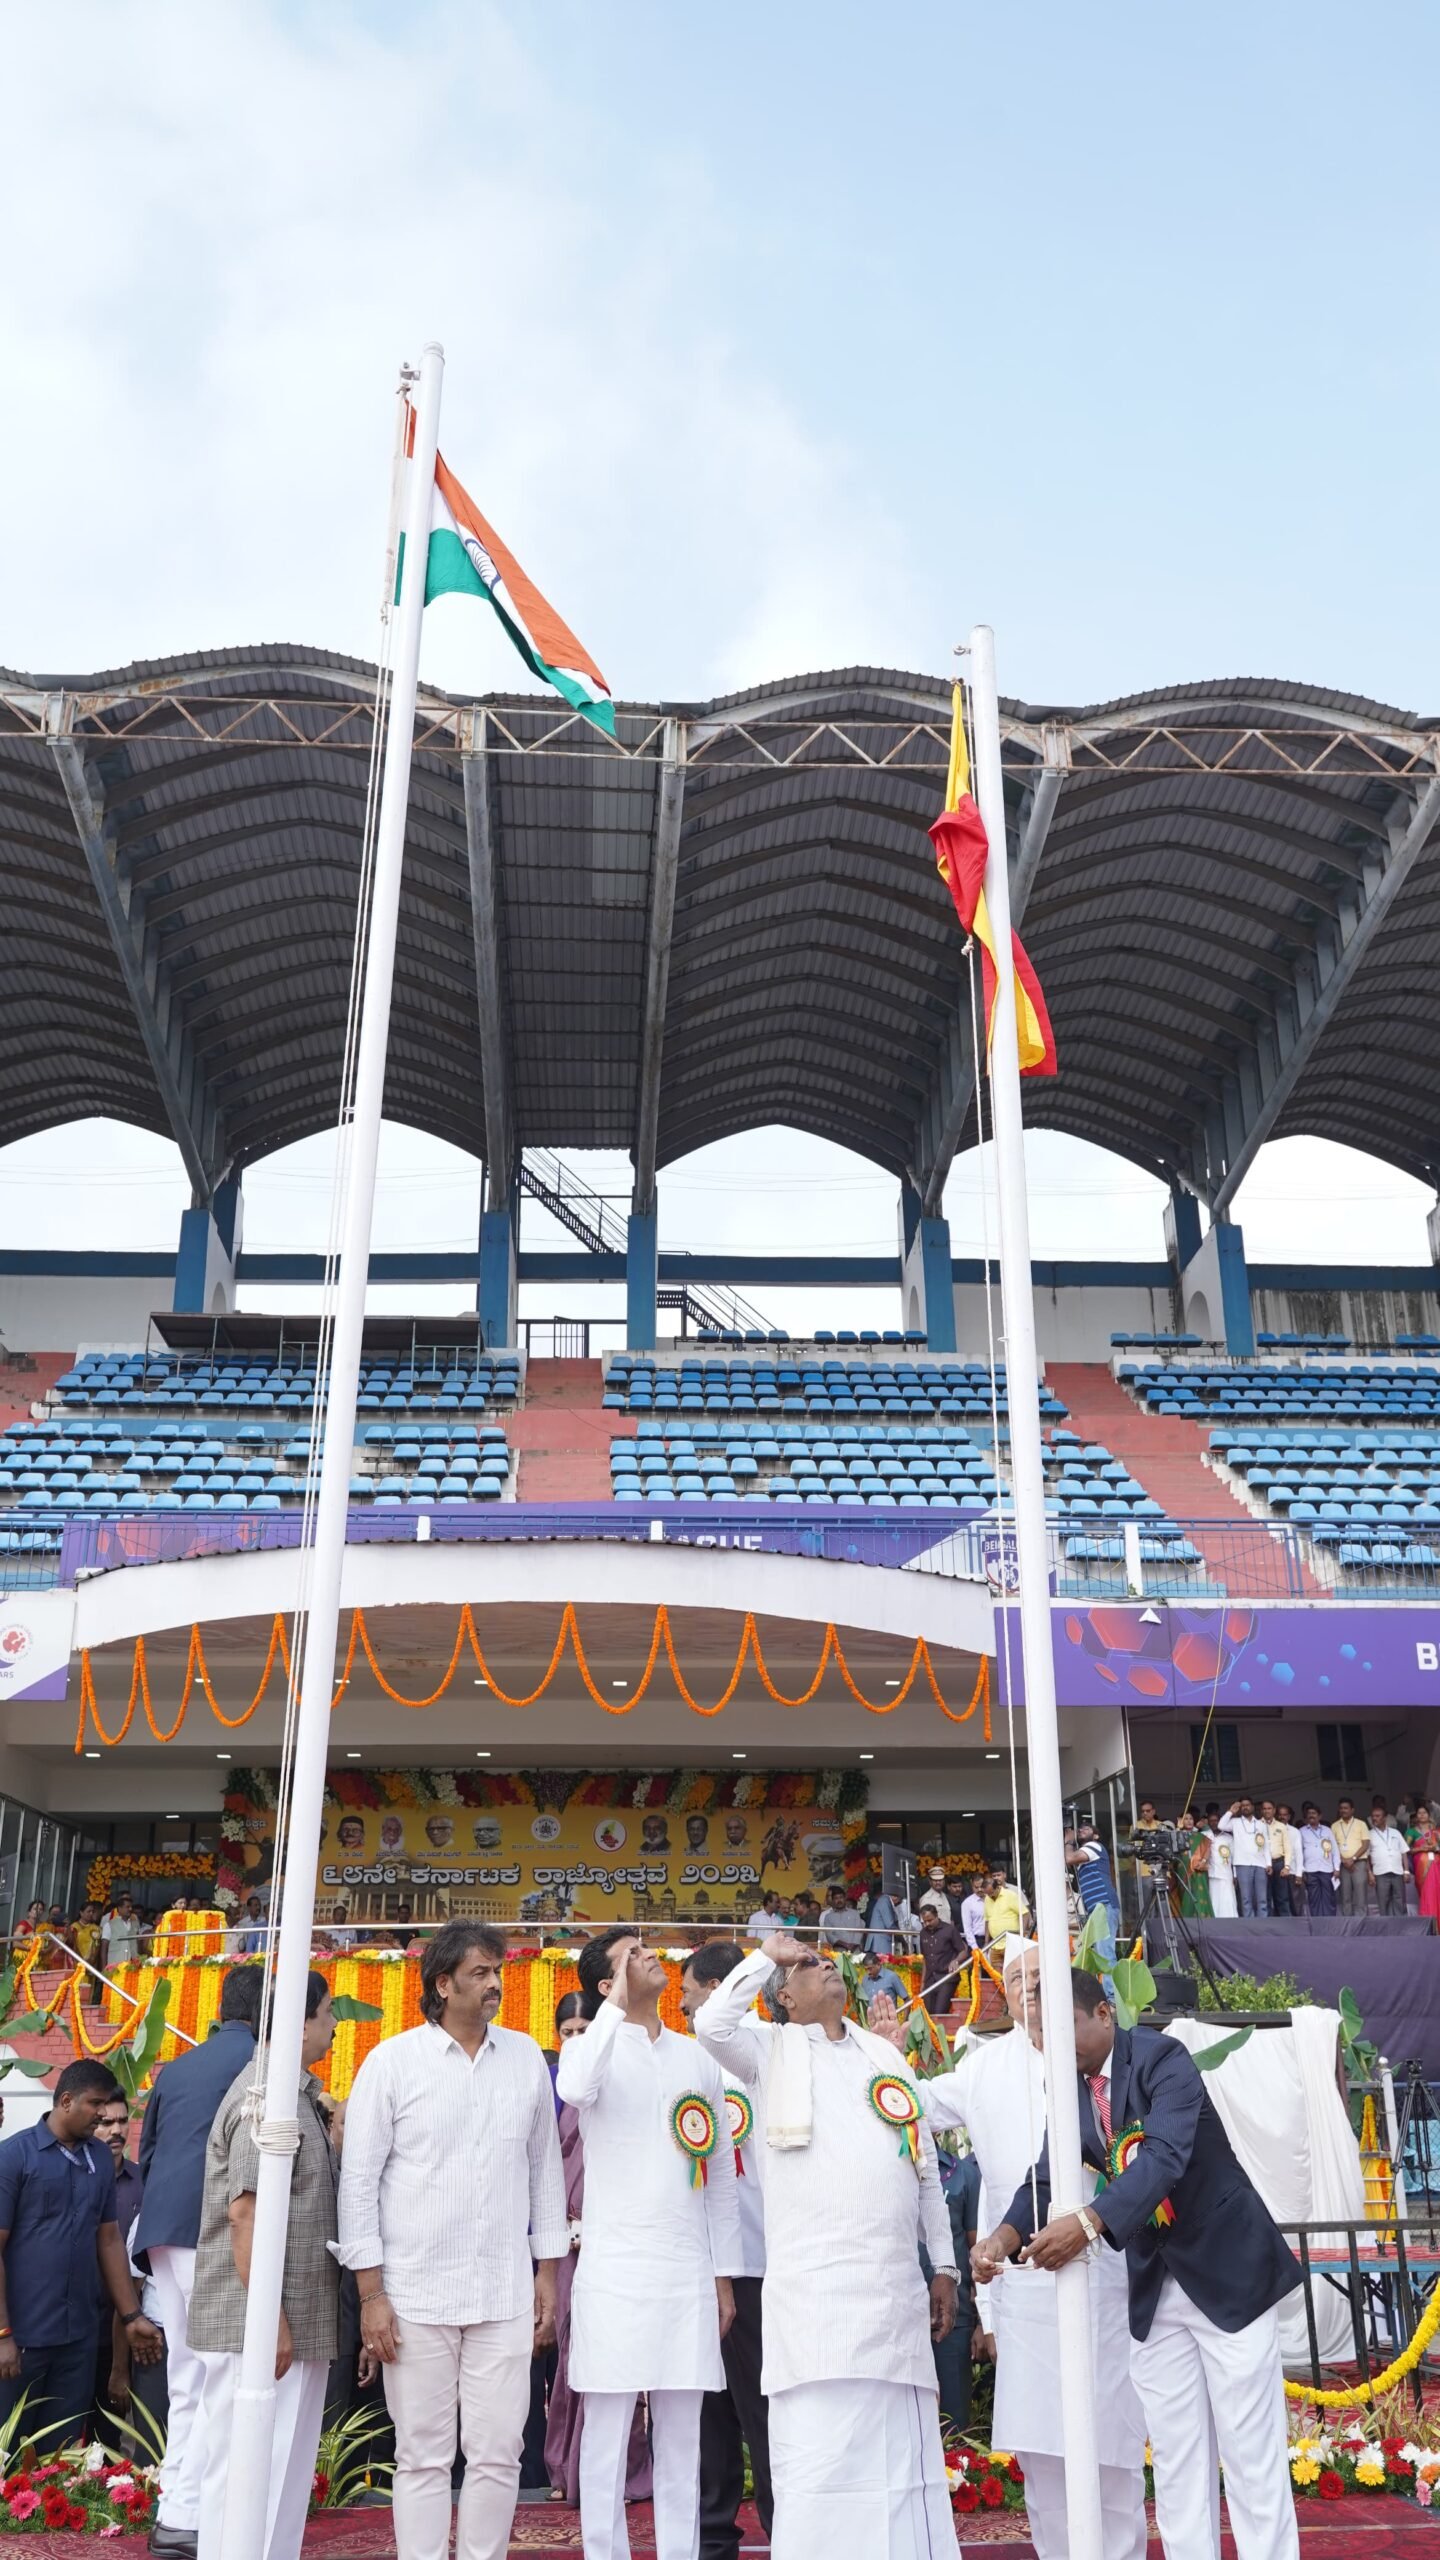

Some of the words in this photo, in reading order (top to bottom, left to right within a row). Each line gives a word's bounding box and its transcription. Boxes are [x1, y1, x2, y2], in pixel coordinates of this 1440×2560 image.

[1415, 1642, 1440, 1670] B
[323, 1863, 397, 1884] ೬೮ನೇ
[410, 1862, 520, 1884] ಕರ್ನಾಟಕ
[533, 1862, 667, 1892] ರಾಜ್ಯೋತ್ಸವ
[680, 1864, 760, 1884] ೨೦೨೩
